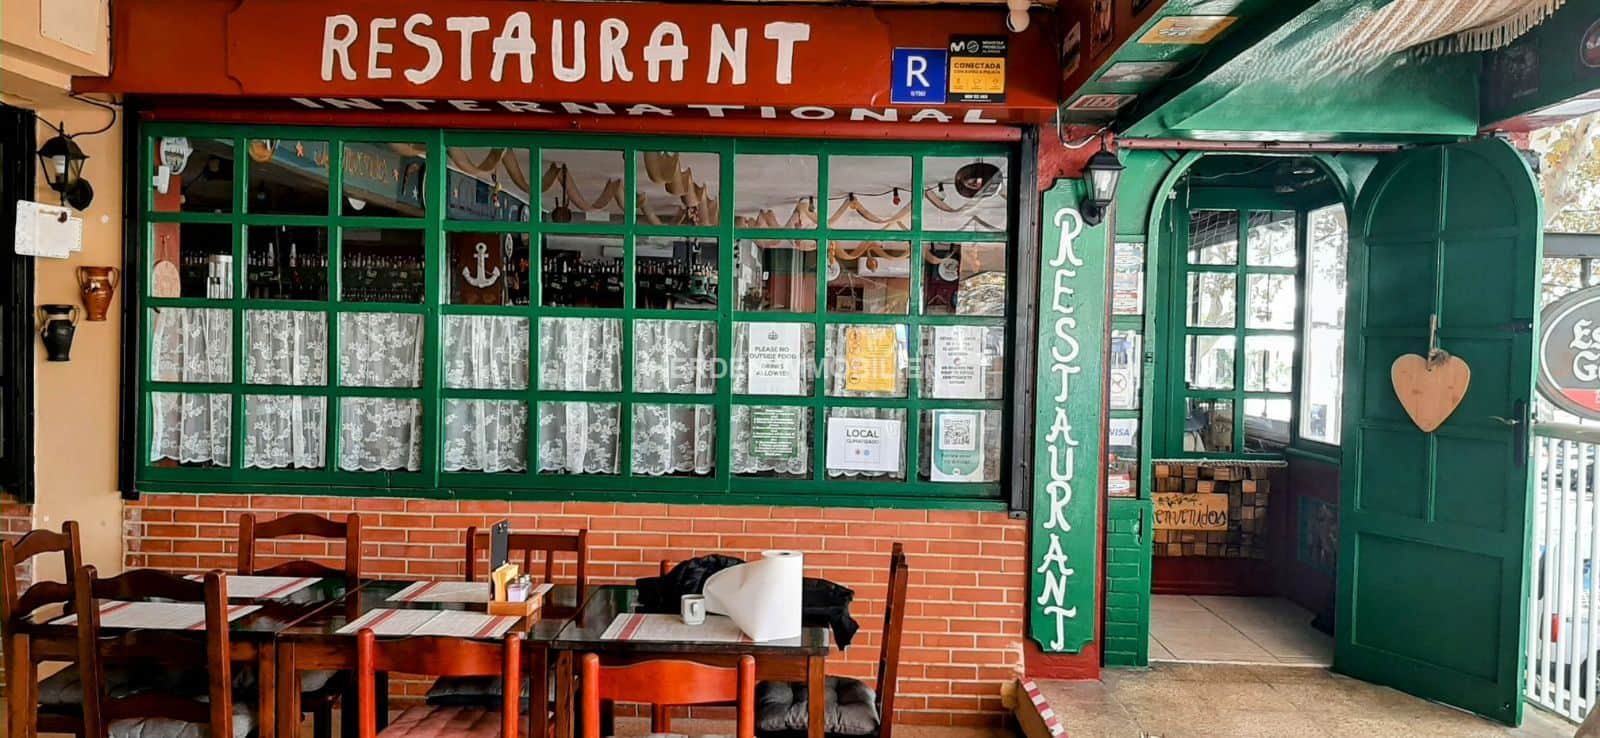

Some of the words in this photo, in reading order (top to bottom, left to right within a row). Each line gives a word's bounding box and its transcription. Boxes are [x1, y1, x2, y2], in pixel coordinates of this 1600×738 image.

[321, 11, 811, 85] RESTAURANT
[906, 55, 930, 88] R
[953, 62, 1001, 70] CONECTADA
[290, 98, 998, 123] INTERNATIONAL
[1572, 350, 1600, 382] G
[846, 429, 880, 439] LOCAL
[1036, 207, 1084, 653] RESTAURANT
